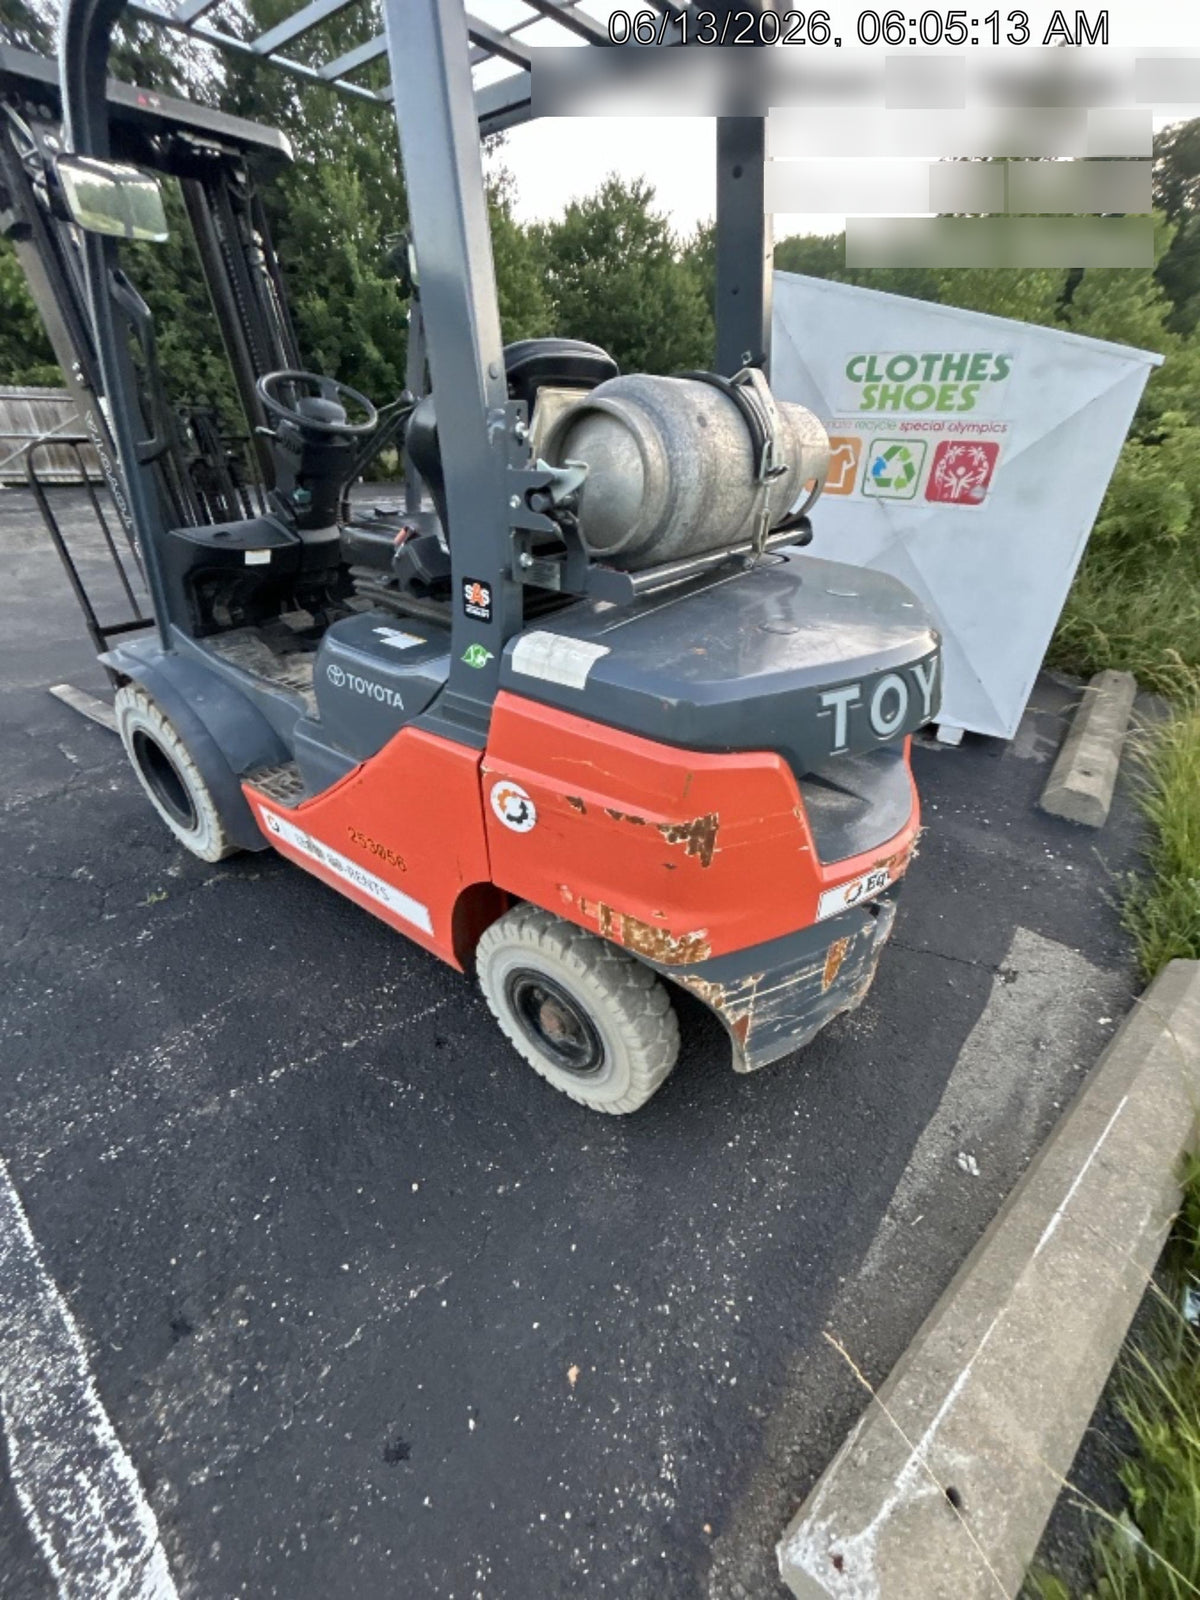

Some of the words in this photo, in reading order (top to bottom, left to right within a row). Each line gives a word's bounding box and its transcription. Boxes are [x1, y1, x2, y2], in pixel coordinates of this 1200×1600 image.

[846, 353, 1014, 382] CLOTHES
[859, 384, 981, 412] SHOES
[899, 421, 945, 433] special
[947, 421, 1009, 435] olympics
[346, 672, 405, 711] TOYOTA
[818, 655, 938, 755] TOY
[867, 871, 890, 893] Eq
